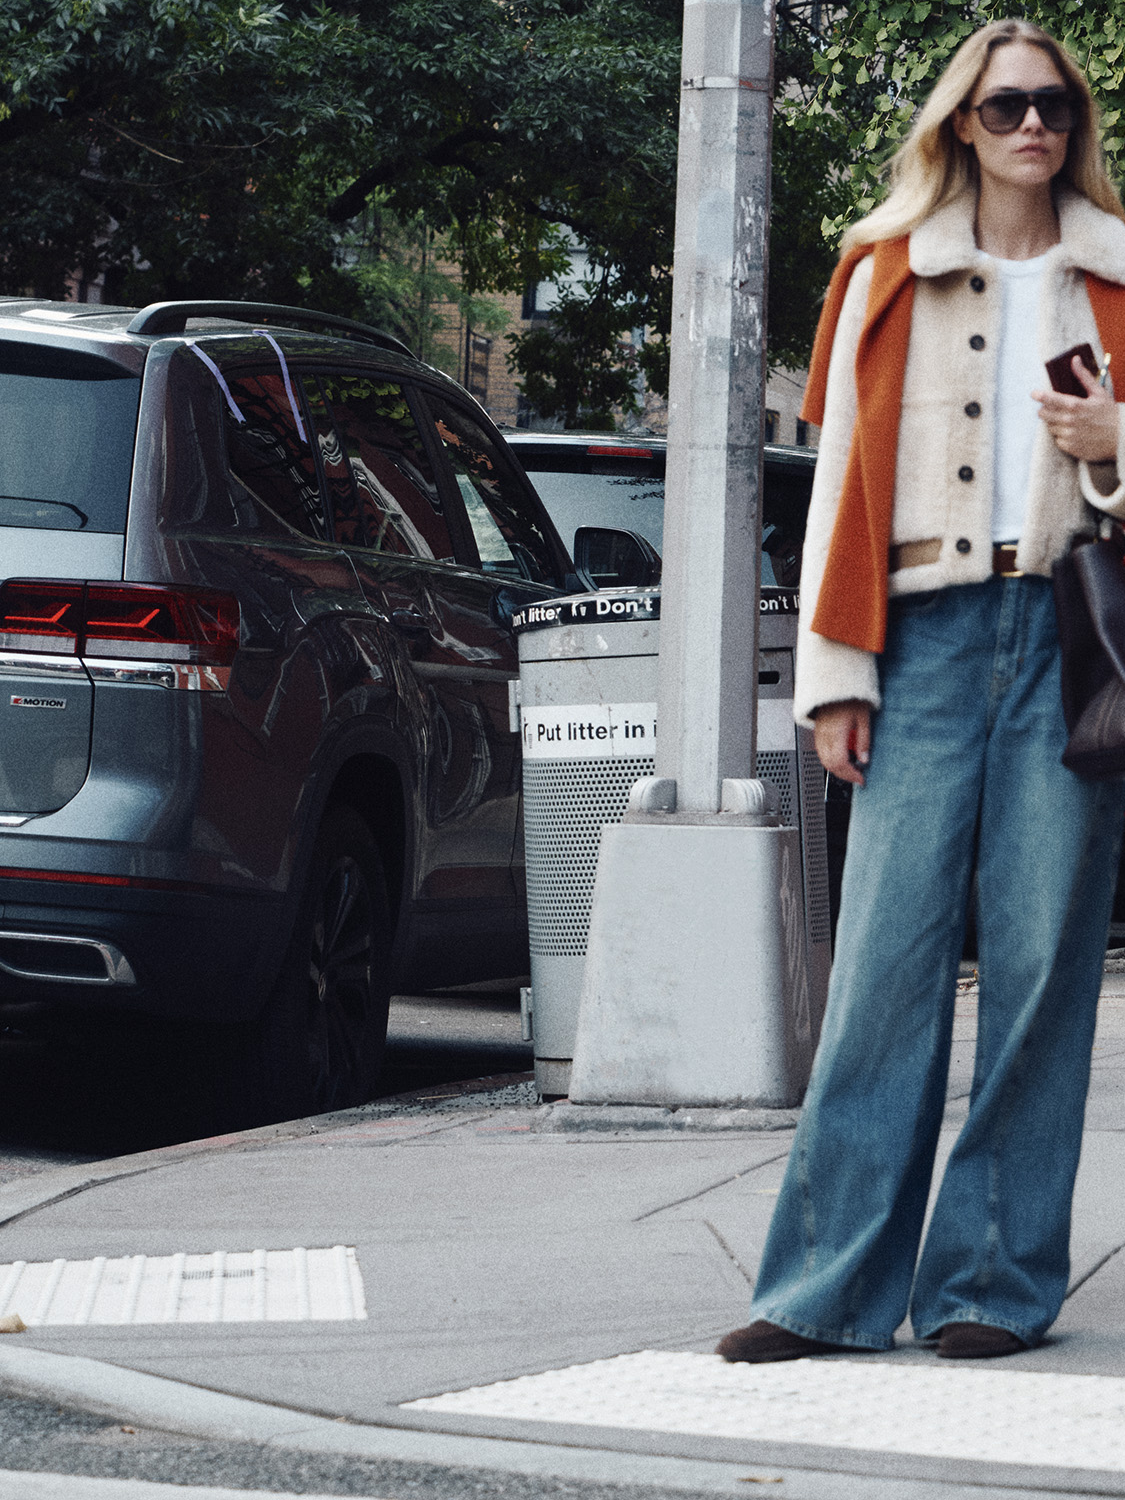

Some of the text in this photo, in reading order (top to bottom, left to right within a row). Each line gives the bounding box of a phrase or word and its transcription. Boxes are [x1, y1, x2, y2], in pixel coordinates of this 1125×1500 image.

[596, 598, 653, 615] Don't
[759, 595, 789, 611] on't
[528, 607, 562, 623] litter
[537, 723, 562, 742] Put
[568, 722, 618, 741] litter
[625, 720, 645, 739] in
